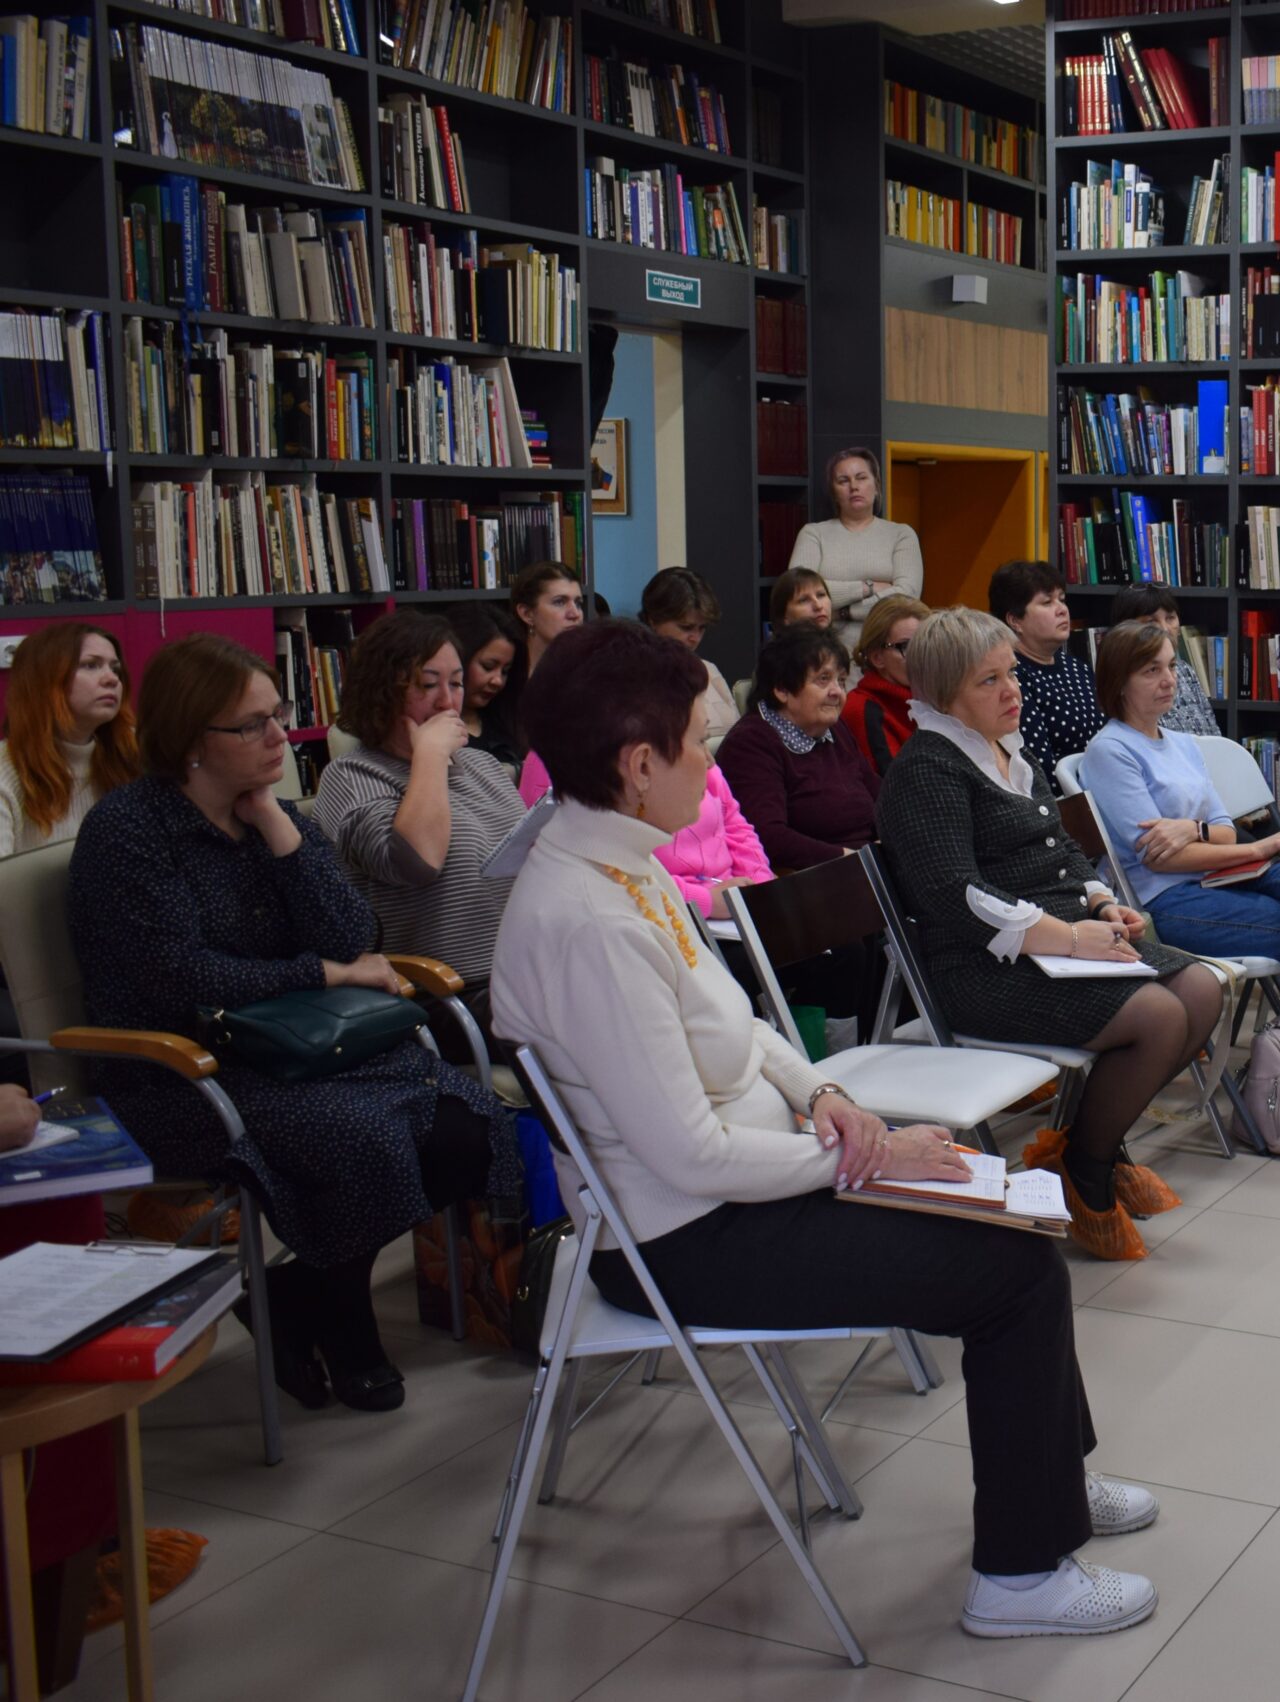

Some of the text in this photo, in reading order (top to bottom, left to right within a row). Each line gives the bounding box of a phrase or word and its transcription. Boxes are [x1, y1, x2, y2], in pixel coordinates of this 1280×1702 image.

[415, 112, 426, 200] Александр МАТВЕЕВ
[183, 186, 193, 286] РУССКАЯ ЖИВОПИСЬ
[207, 224, 217, 275] ГАЛЕРЕЯ
[653, 277, 693, 291] СЛУЖЕБНЫЙ
[662, 289, 684, 301] ВЫХОД
